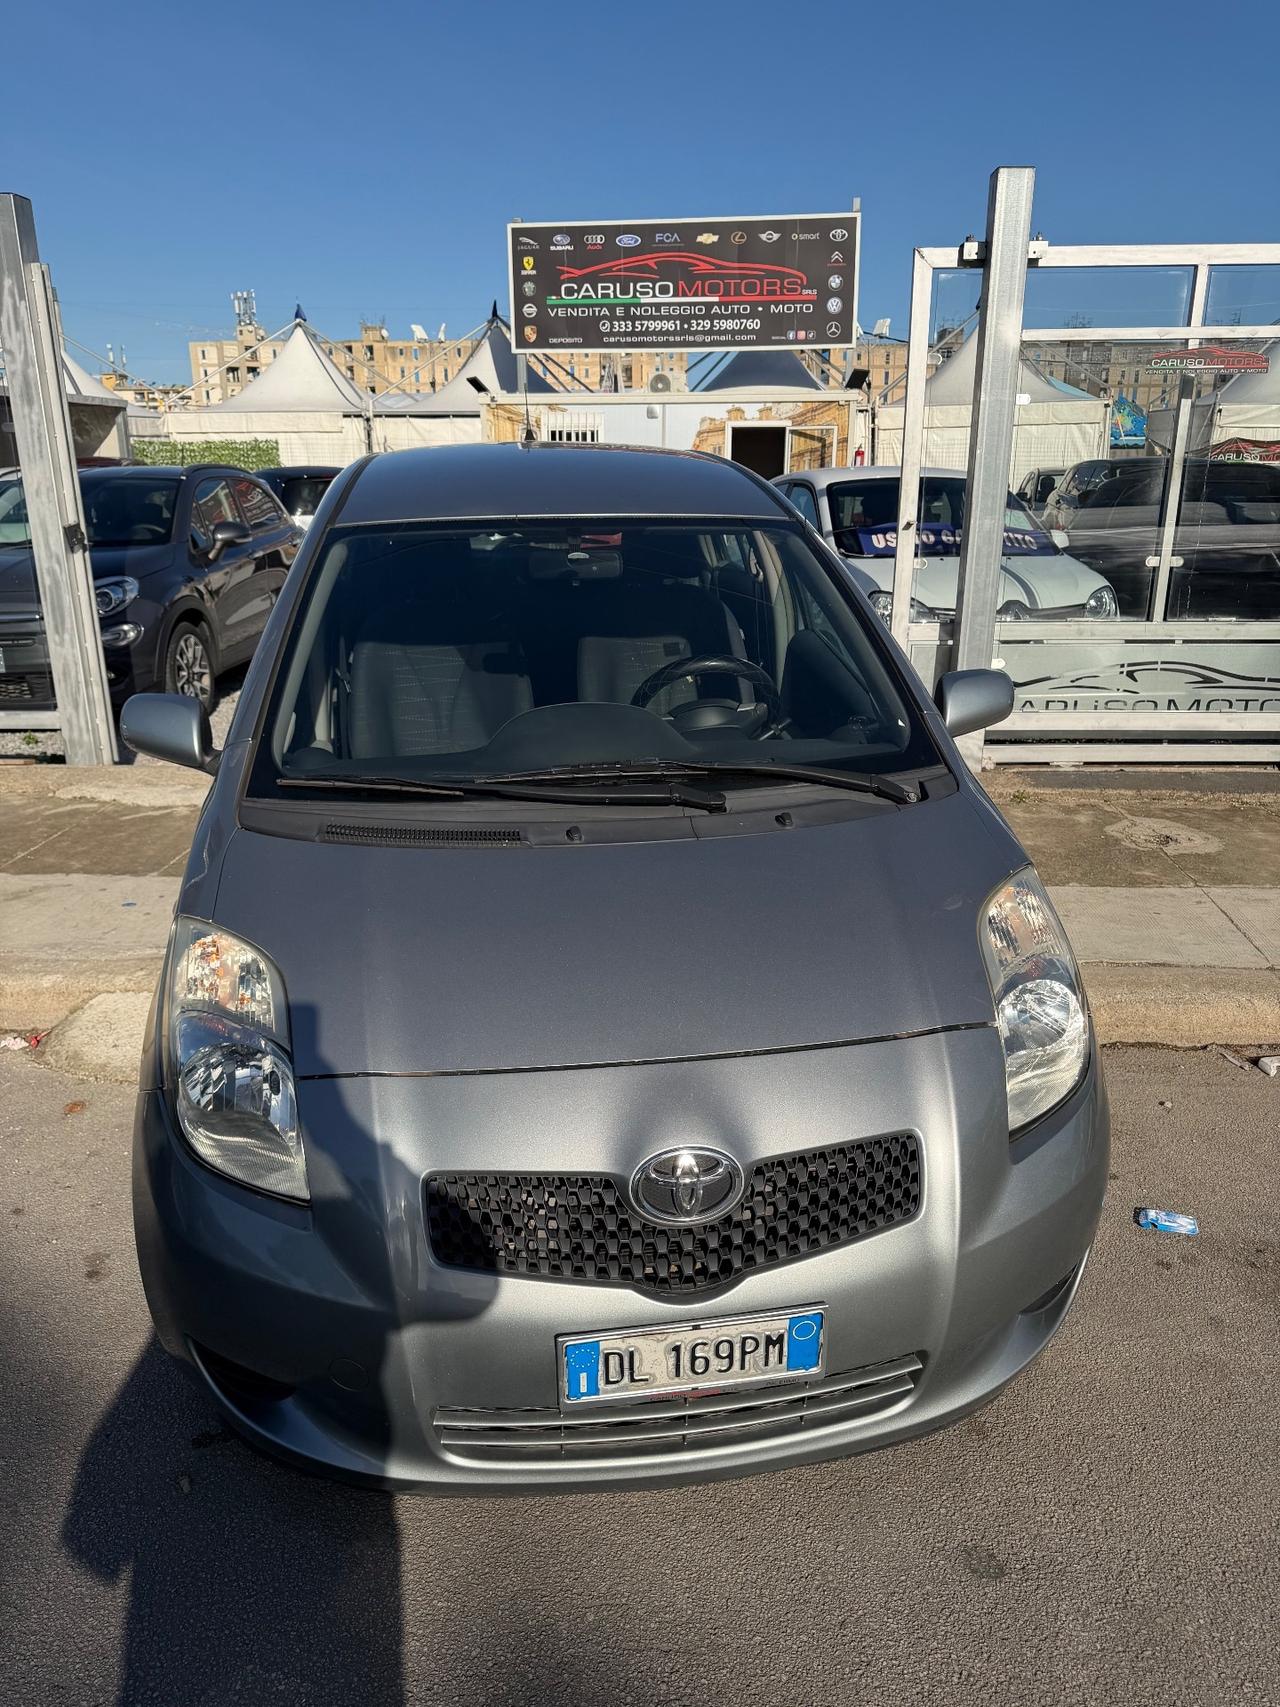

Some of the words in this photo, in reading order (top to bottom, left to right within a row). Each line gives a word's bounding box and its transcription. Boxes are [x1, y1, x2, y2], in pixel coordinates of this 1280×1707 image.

[655, 232, 680, 243] FCA
[799, 232, 820, 240] smart
[561, 281, 674, 299] CARUSO
[678, 278, 802, 298] MOTORS
[547, 306, 610, 317] VENDITA
[616, 306, 625, 317] E
[630, 304, 706, 316] NOLEGGIO
[711, 304, 750, 315] AUTO
[770, 303, 814, 314] MOTO
[612, 320, 632, 332] 333
[634, 319, 681, 332] 5799961
[690, 319, 711, 331] 329
[713, 318, 761, 331] 5980760
[603, 333, 757, 343] carusomotorssrls@gmail.com
[1151, 358, 1205, 368] CARUSO
[603, 1348, 649, 1386] DL
[671, 1332, 785, 1377] 169PM
